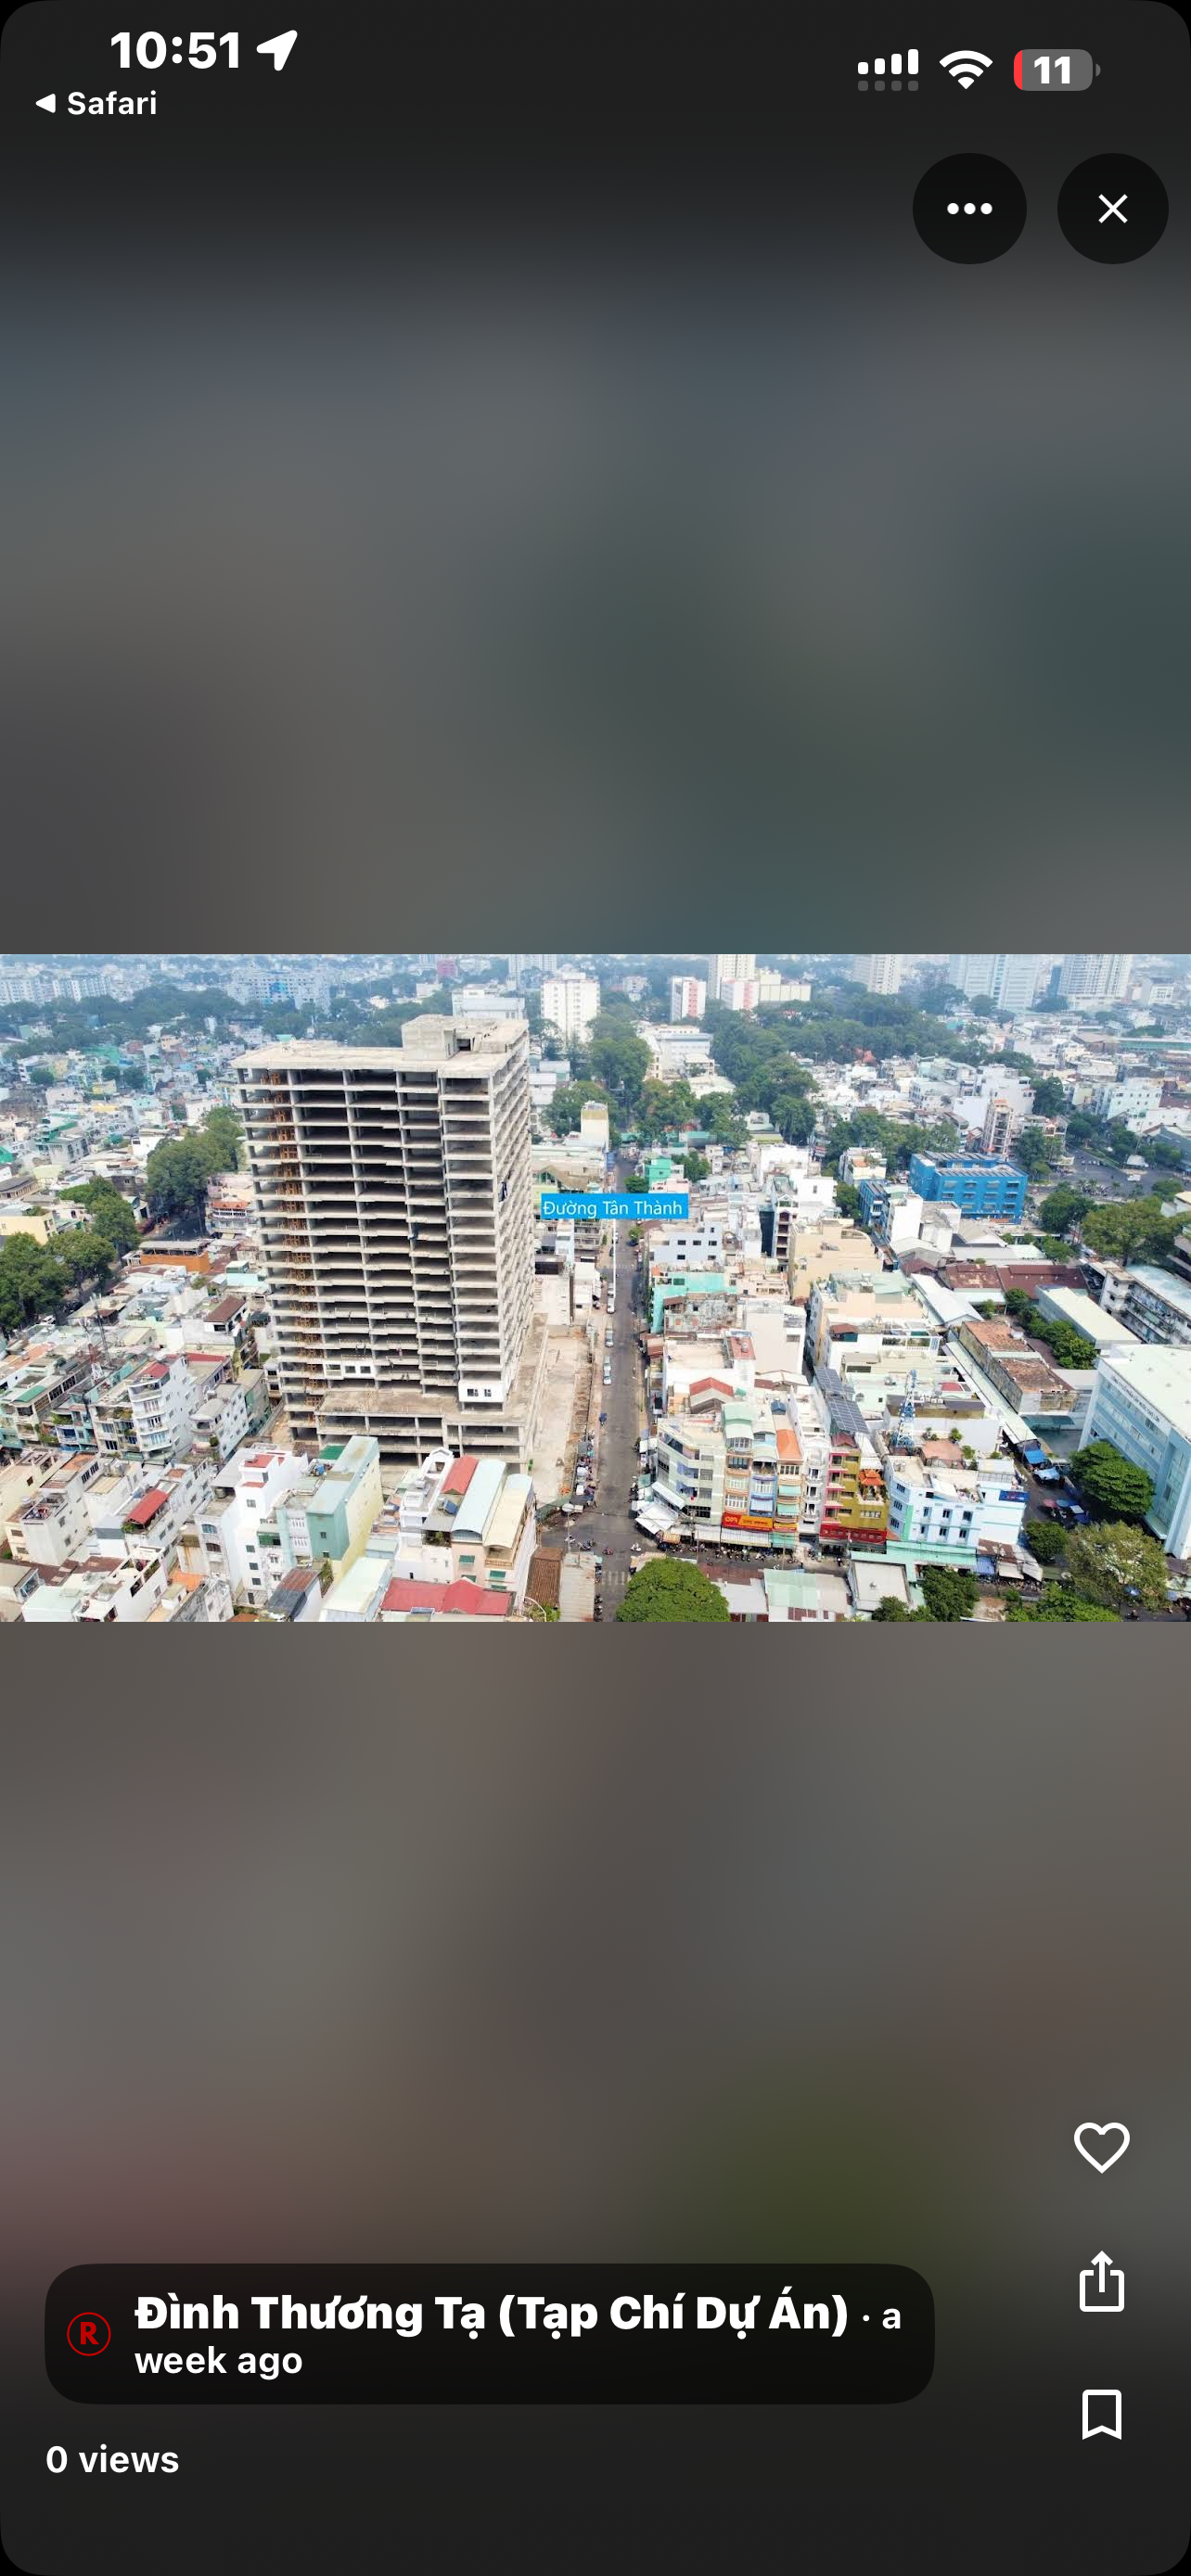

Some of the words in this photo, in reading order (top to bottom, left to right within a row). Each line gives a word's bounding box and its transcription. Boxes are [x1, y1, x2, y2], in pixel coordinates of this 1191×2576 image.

[110, 31, 241, 70] 10:51
[1033, 56, 1070, 84] 11
[67, 89, 157, 116] Safari
[134, 2292, 239, 2329] Đình
[250, 2294, 423, 2338] Thương
[434, 2296, 485, 2340] Tạ
[499, 2294, 598, 2340] (Tạp
[609, 2292, 686, 2330] Chí
[697, 2295, 762, 2340] Dự
[768, 2286, 848, 2338] Án)
[882, 2308, 901, 2329] a
[134, 2345, 227, 2374] week
[237, 2353, 302, 2380] ago
[45, 2445, 68, 2474] 0
[78, 2443, 179, 2473] views
